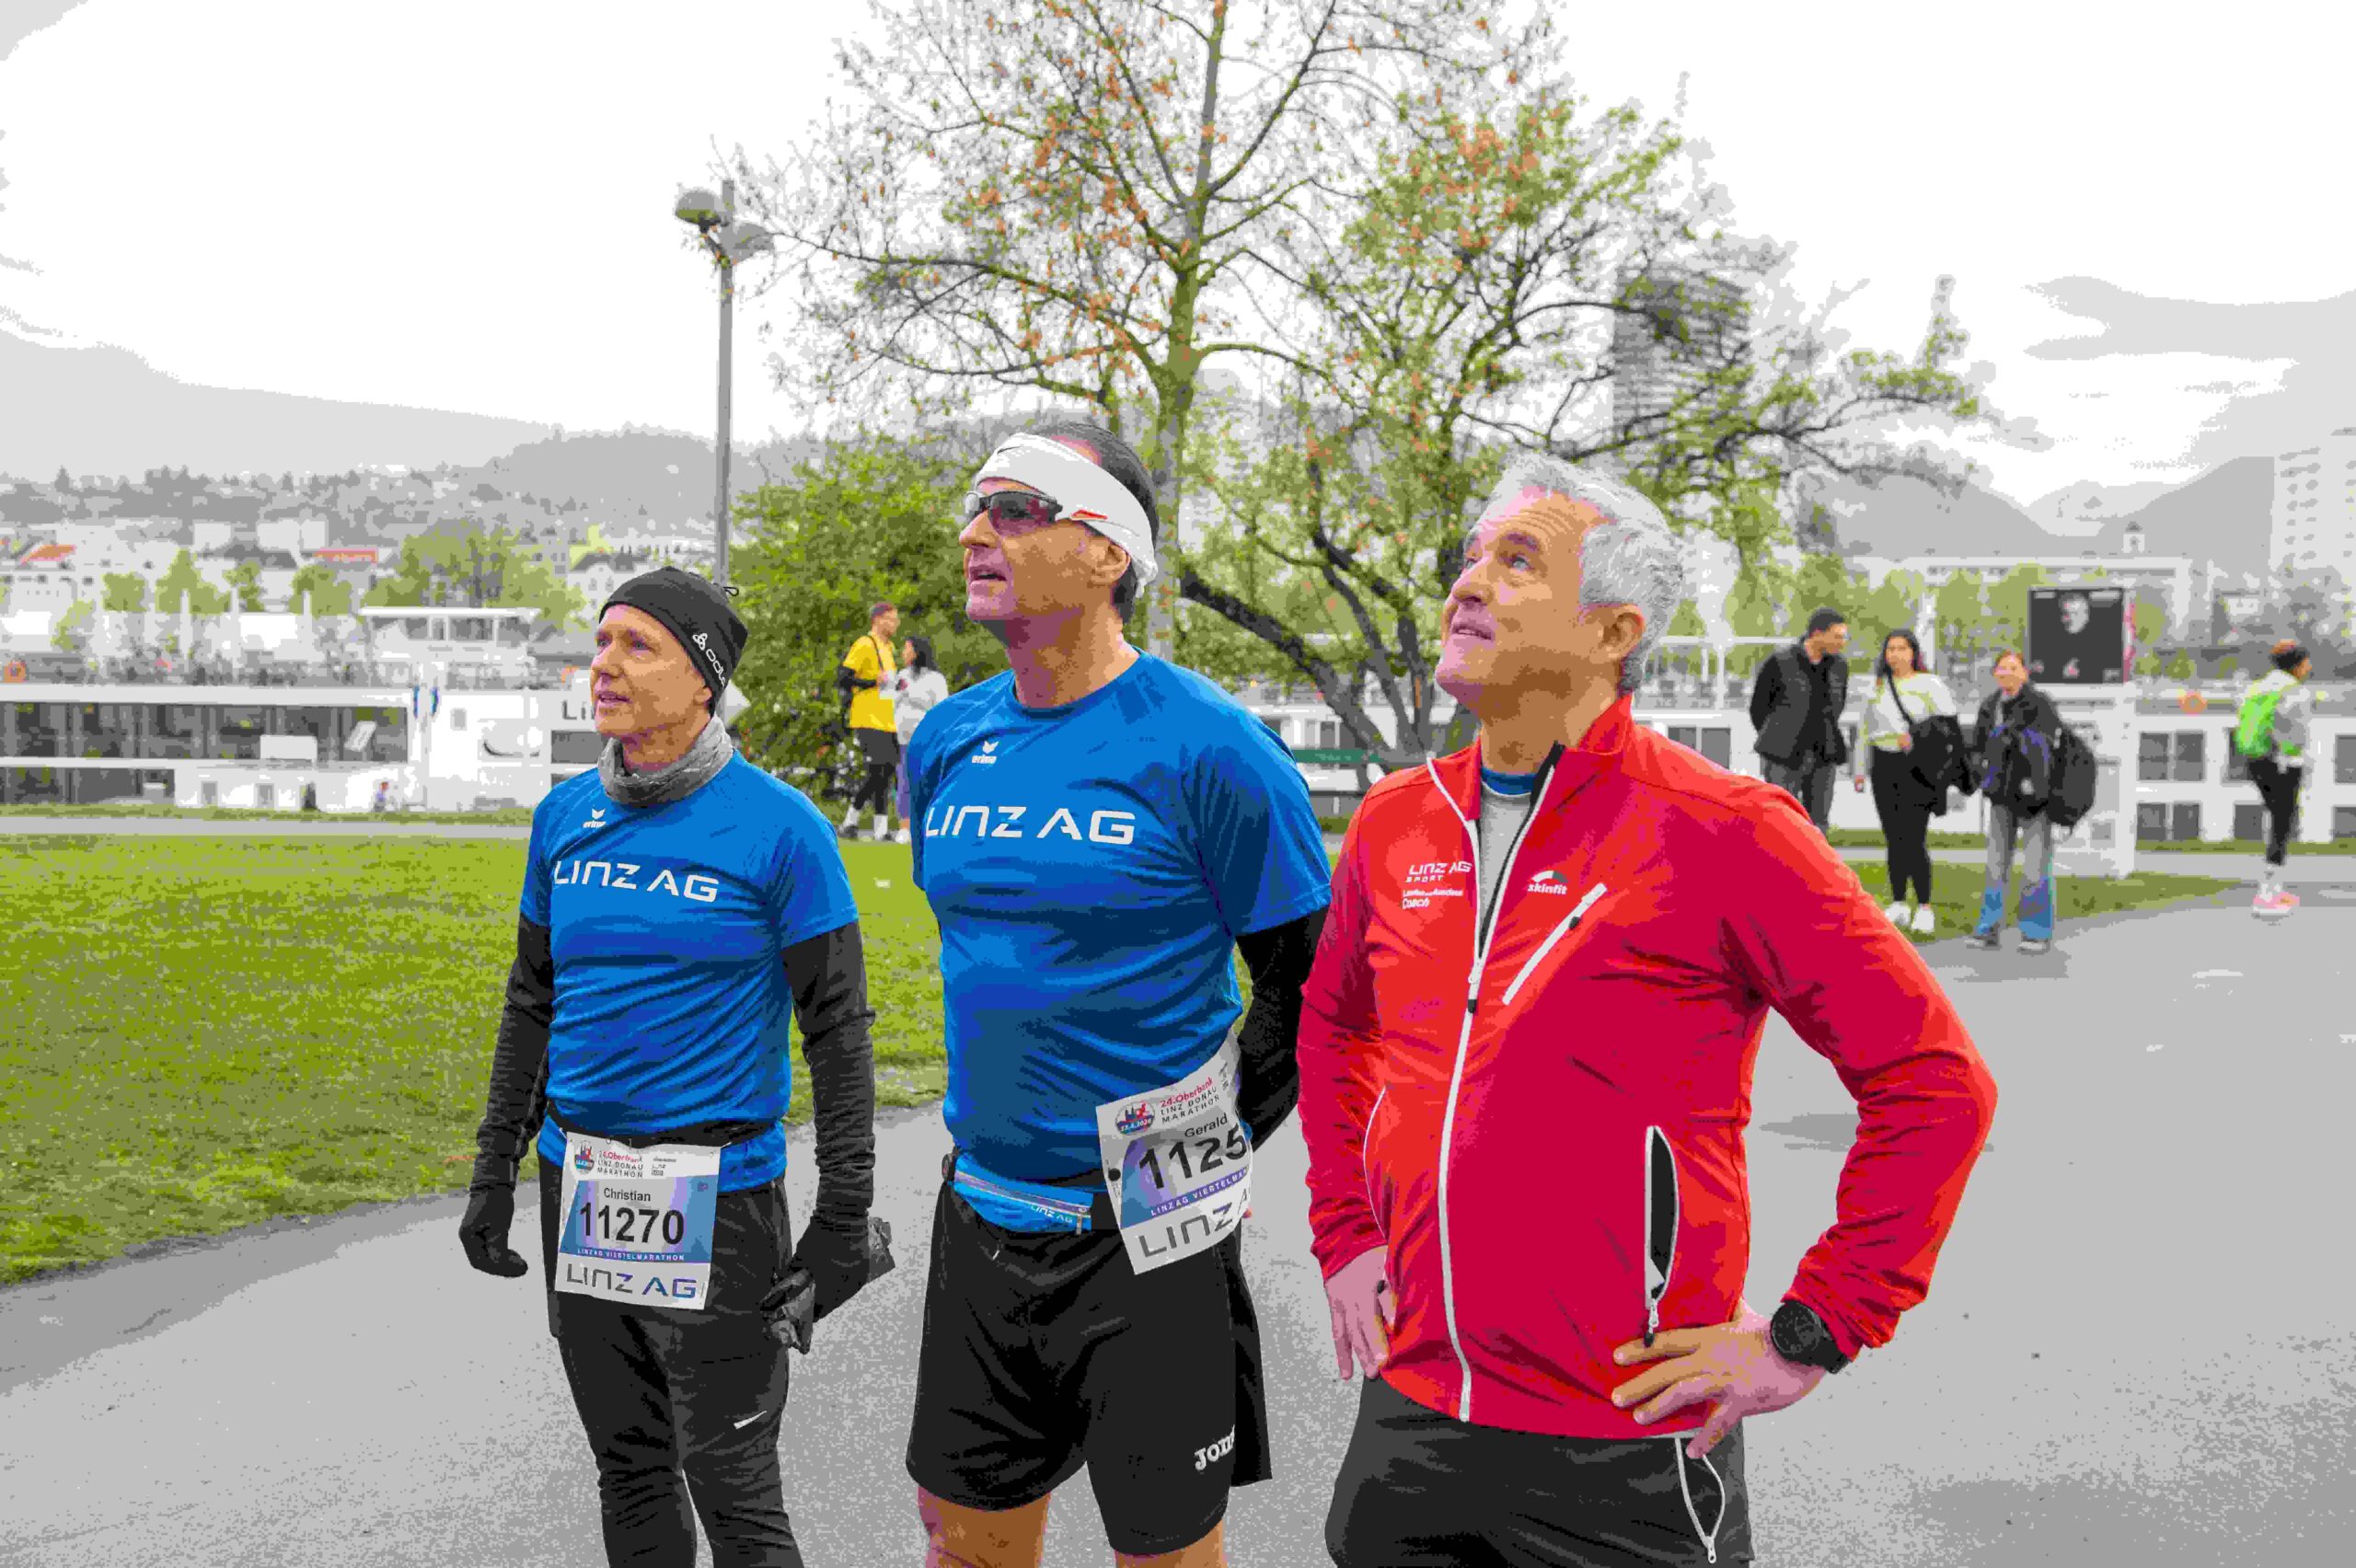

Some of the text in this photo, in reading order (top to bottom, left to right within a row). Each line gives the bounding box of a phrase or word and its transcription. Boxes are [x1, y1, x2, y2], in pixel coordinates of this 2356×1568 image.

[926, 805, 1136, 846] LINZ AG
[554, 860, 720, 903] LINZ AG
[1409, 860, 1472, 875] LINZ AG
[1527, 882, 1567, 895] skinfit
[1161, 1086, 1217, 1115] LINZ DONAU
[1162, 1094, 1219, 1124] MARATHON
[1184, 1113, 1228, 1137] Gerald
[597, 1167, 643, 1178] MARATHON
[615, 1161, 643, 1170] DONAU
[604, 1187, 651, 1202] Christian
[580, 1202, 685, 1245] 11270
[1138, 1202, 1233, 1257] LINZ
[567, 1263, 633, 1294] LINZ
[642, 1276, 697, 1298] AG
